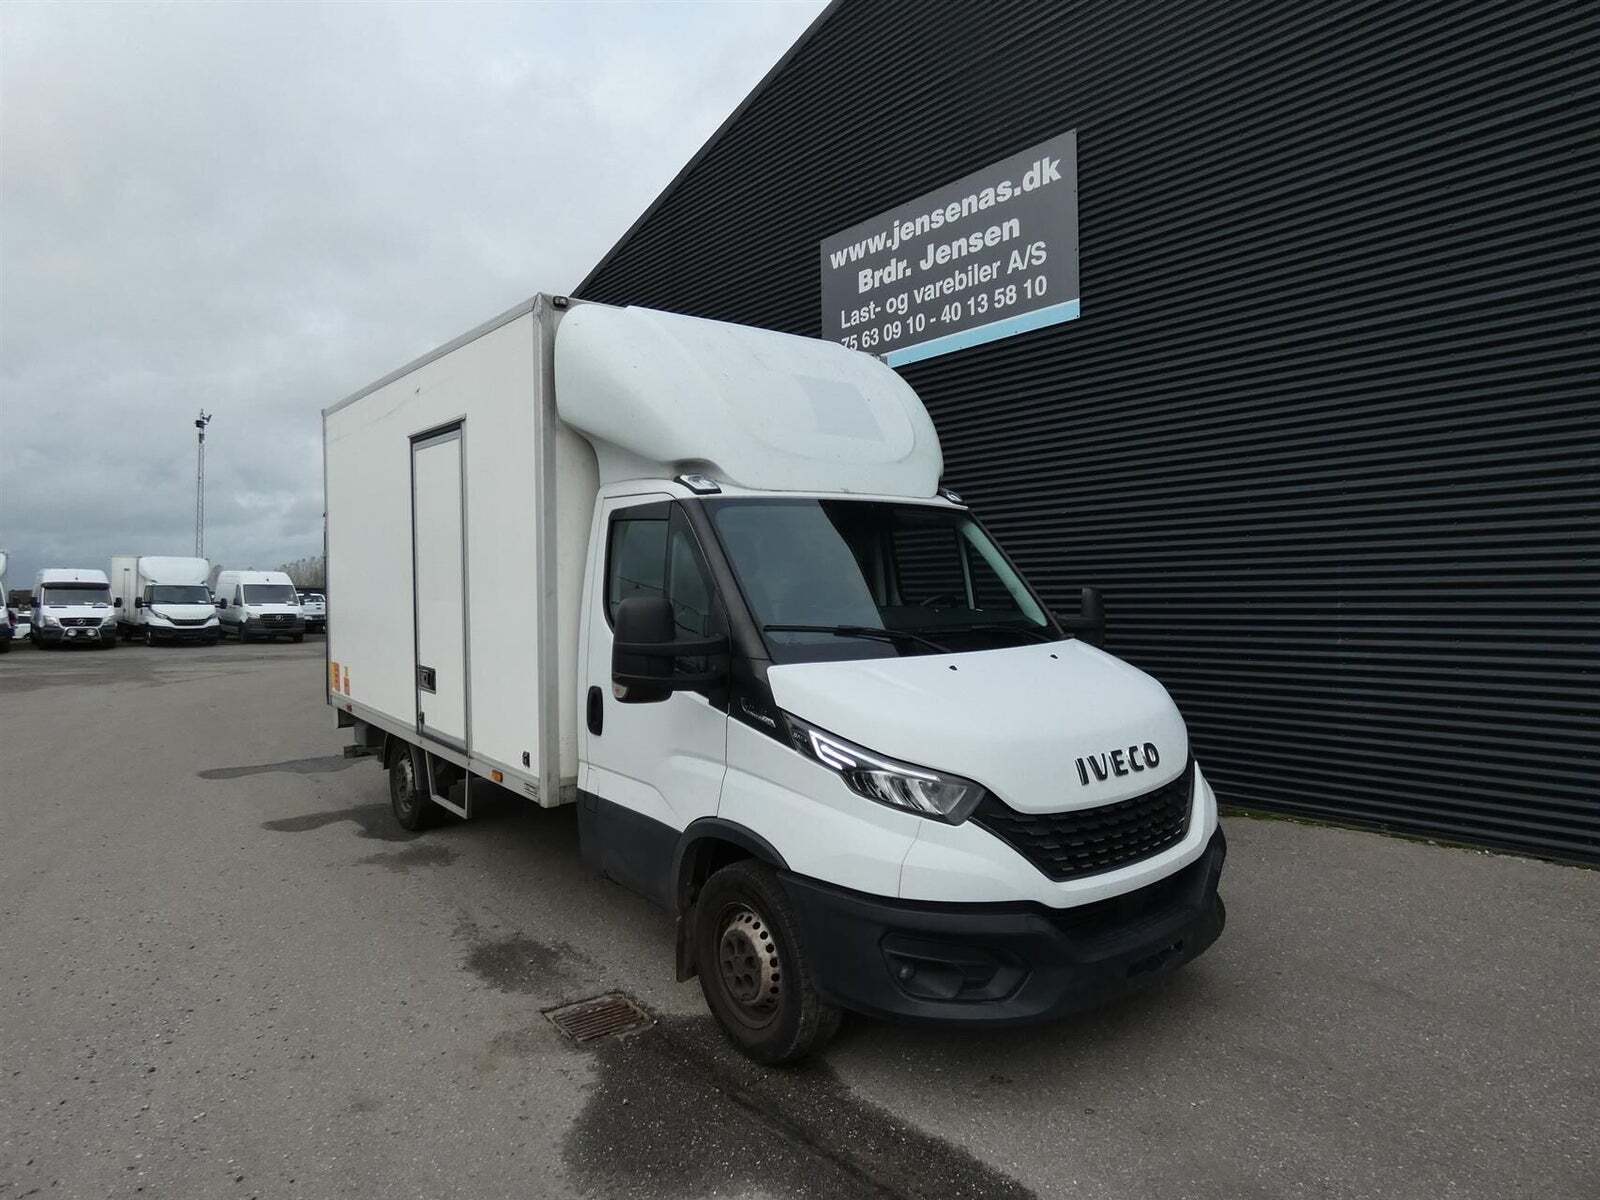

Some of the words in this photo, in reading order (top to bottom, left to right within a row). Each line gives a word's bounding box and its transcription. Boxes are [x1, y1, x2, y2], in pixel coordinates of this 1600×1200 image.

[830, 157, 1061, 269] www.jensenas.dk
[841, 300, 881, 328] Last-
[886, 292, 908, 315] og
[914, 260, 1000, 304] varebiler
[1007, 241, 1047, 274] A/S
[858, 259, 911, 293] Brdr.
[920, 218, 1020, 271] Jensen
[842, 333, 857, 351] 75
[863, 327, 879, 348] 63
[884, 321, 901, 342] 09
[907, 314, 924, 334] 10
[941, 303, 961, 323] 40
[968, 294, 988, 316] 13
[994, 285, 1016, 307] 58
[1024, 275, 1047, 299] 10
[1075, 742, 1160, 785] IVECO
